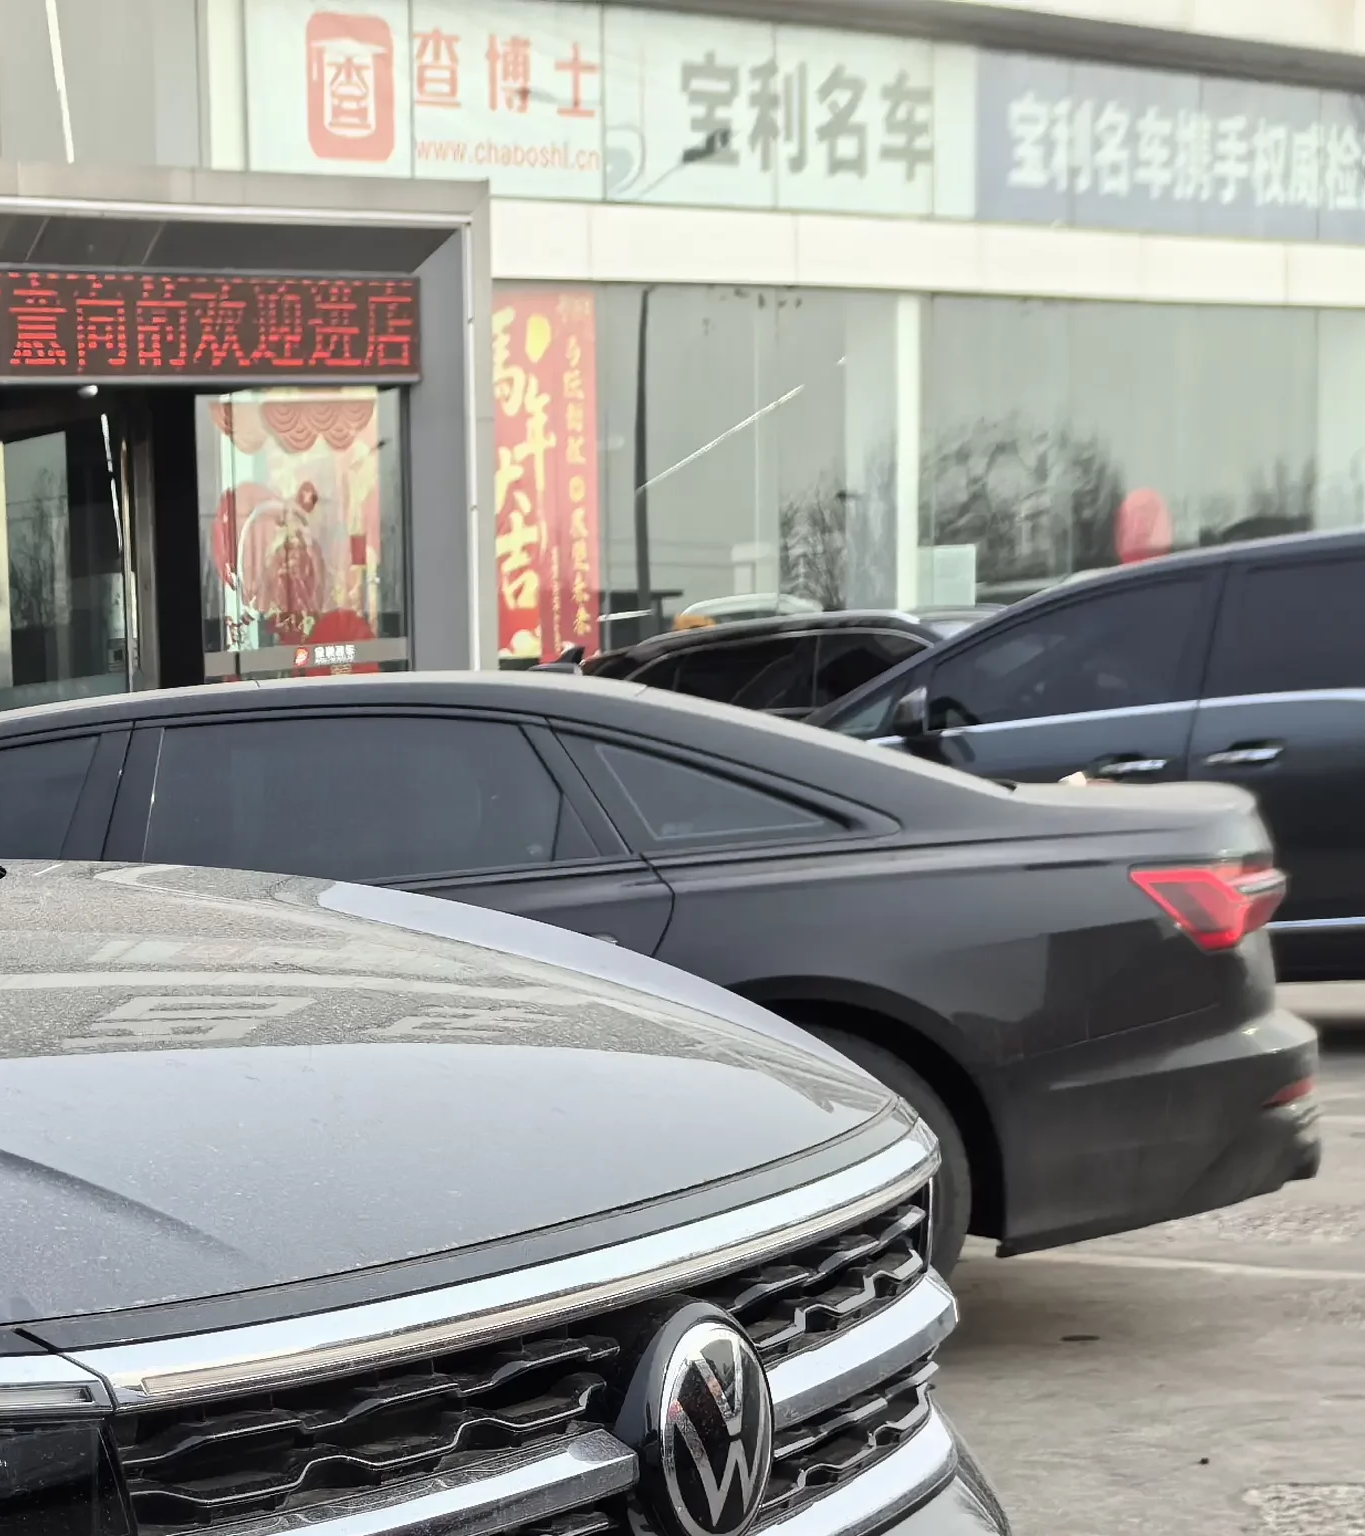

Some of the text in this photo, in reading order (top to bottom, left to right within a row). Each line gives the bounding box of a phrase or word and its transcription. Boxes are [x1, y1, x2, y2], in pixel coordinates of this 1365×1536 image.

[413, 27, 600, 118] 查博士
[680, 51, 935, 182] 宝利名车
[1006, 88, 1365, 212] 宝利名车携手权威检
